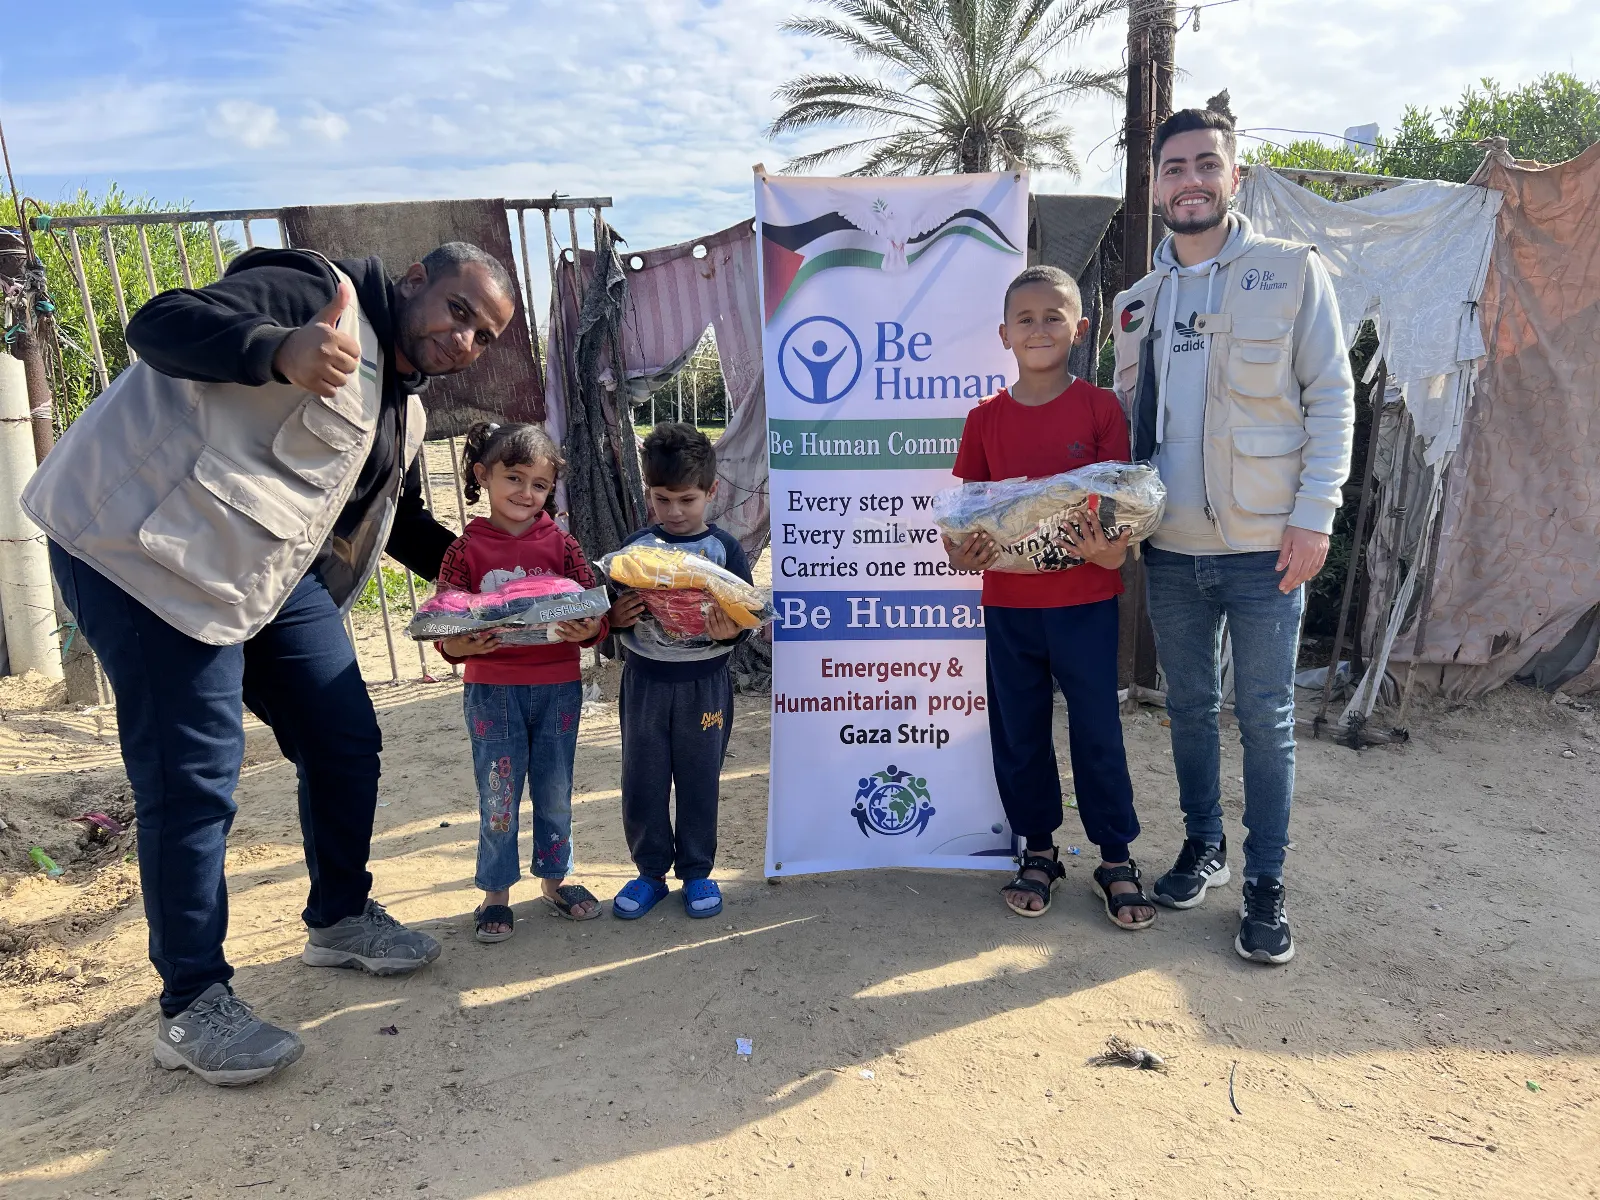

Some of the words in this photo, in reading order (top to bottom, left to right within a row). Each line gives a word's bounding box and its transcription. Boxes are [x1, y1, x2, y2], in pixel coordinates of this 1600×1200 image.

[1260, 281, 1288, 291] Human
[1262, 270, 1275, 281] Be
[874, 321, 933, 363] Be
[874, 366, 1006, 400] Human
[769, 430, 794, 455] Be
[800, 432, 881, 456] Human
[888, 431, 963, 455] Comm
[787, 490, 852, 516] Every
[859, 493, 904, 516] step
[782, 523, 846, 549] Every
[852, 523, 906, 545] smile
[908, 528, 938, 544] we
[780, 555, 858, 578] Carries
[865, 560, 907, 577] one
[540, 600, 592, 622] FASHION
[780, 597, 831, 630] Be
[821, 657, 942, 683] Emergency
[946, 656, 964, 678] &
[774, 690, 917, 714] Humanitarian
[928, 690, 986, 717] proje
[839, 724, 892, 745] Gaza
[897, 723, 950, 749] Strip
